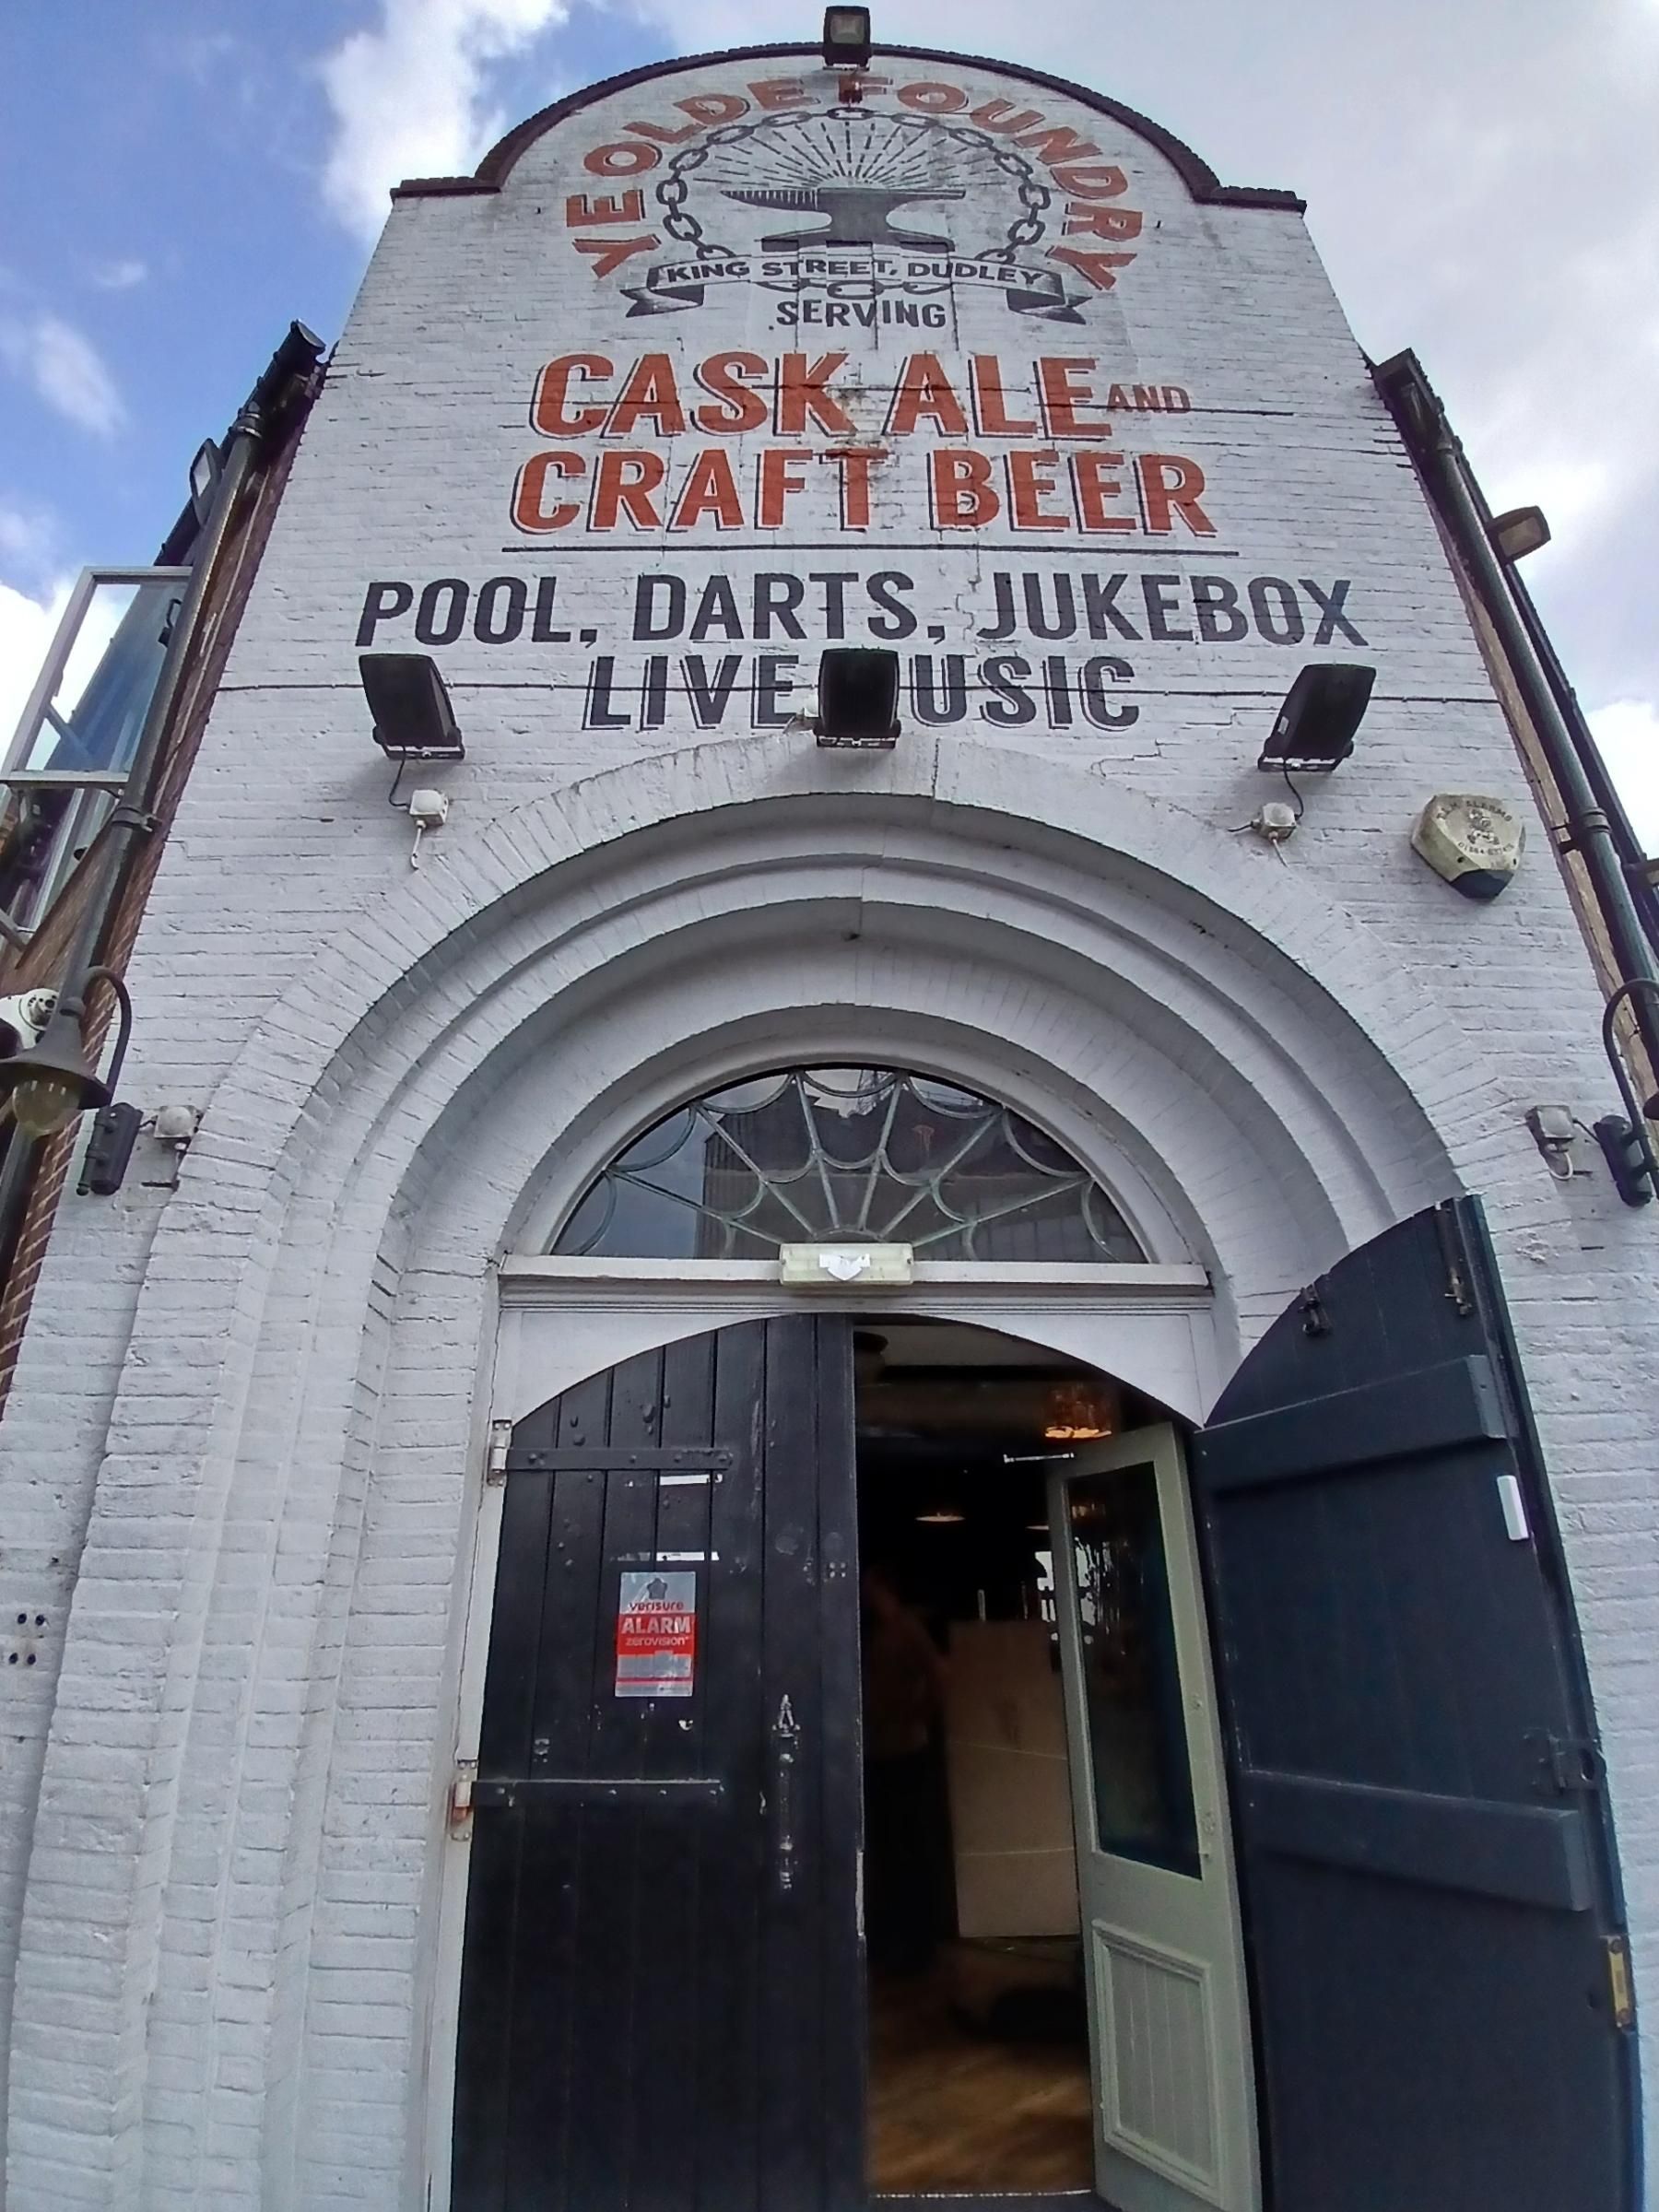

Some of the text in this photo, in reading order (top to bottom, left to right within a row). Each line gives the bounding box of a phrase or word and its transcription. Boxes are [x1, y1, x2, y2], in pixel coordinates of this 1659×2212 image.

[566, 76, 1143, 290] YE OLDE FOUNDRY
[667, 258, 1045, 286] KING STREET, DUDLEY
[776, 300, 947, 328] SERVING
[531, 353, 1191, 441] CASK ALE AND
[511, 449, 1218, 538] CRAFT BEER
[355, 571, 1370, 649] POOL, DARTS, JUKEBOX
[582, 654, 1140, 732] LIVE USIC
[621, 1616, 691, 1634] ALARM
[629, 1601, 684, 1612] verisure
